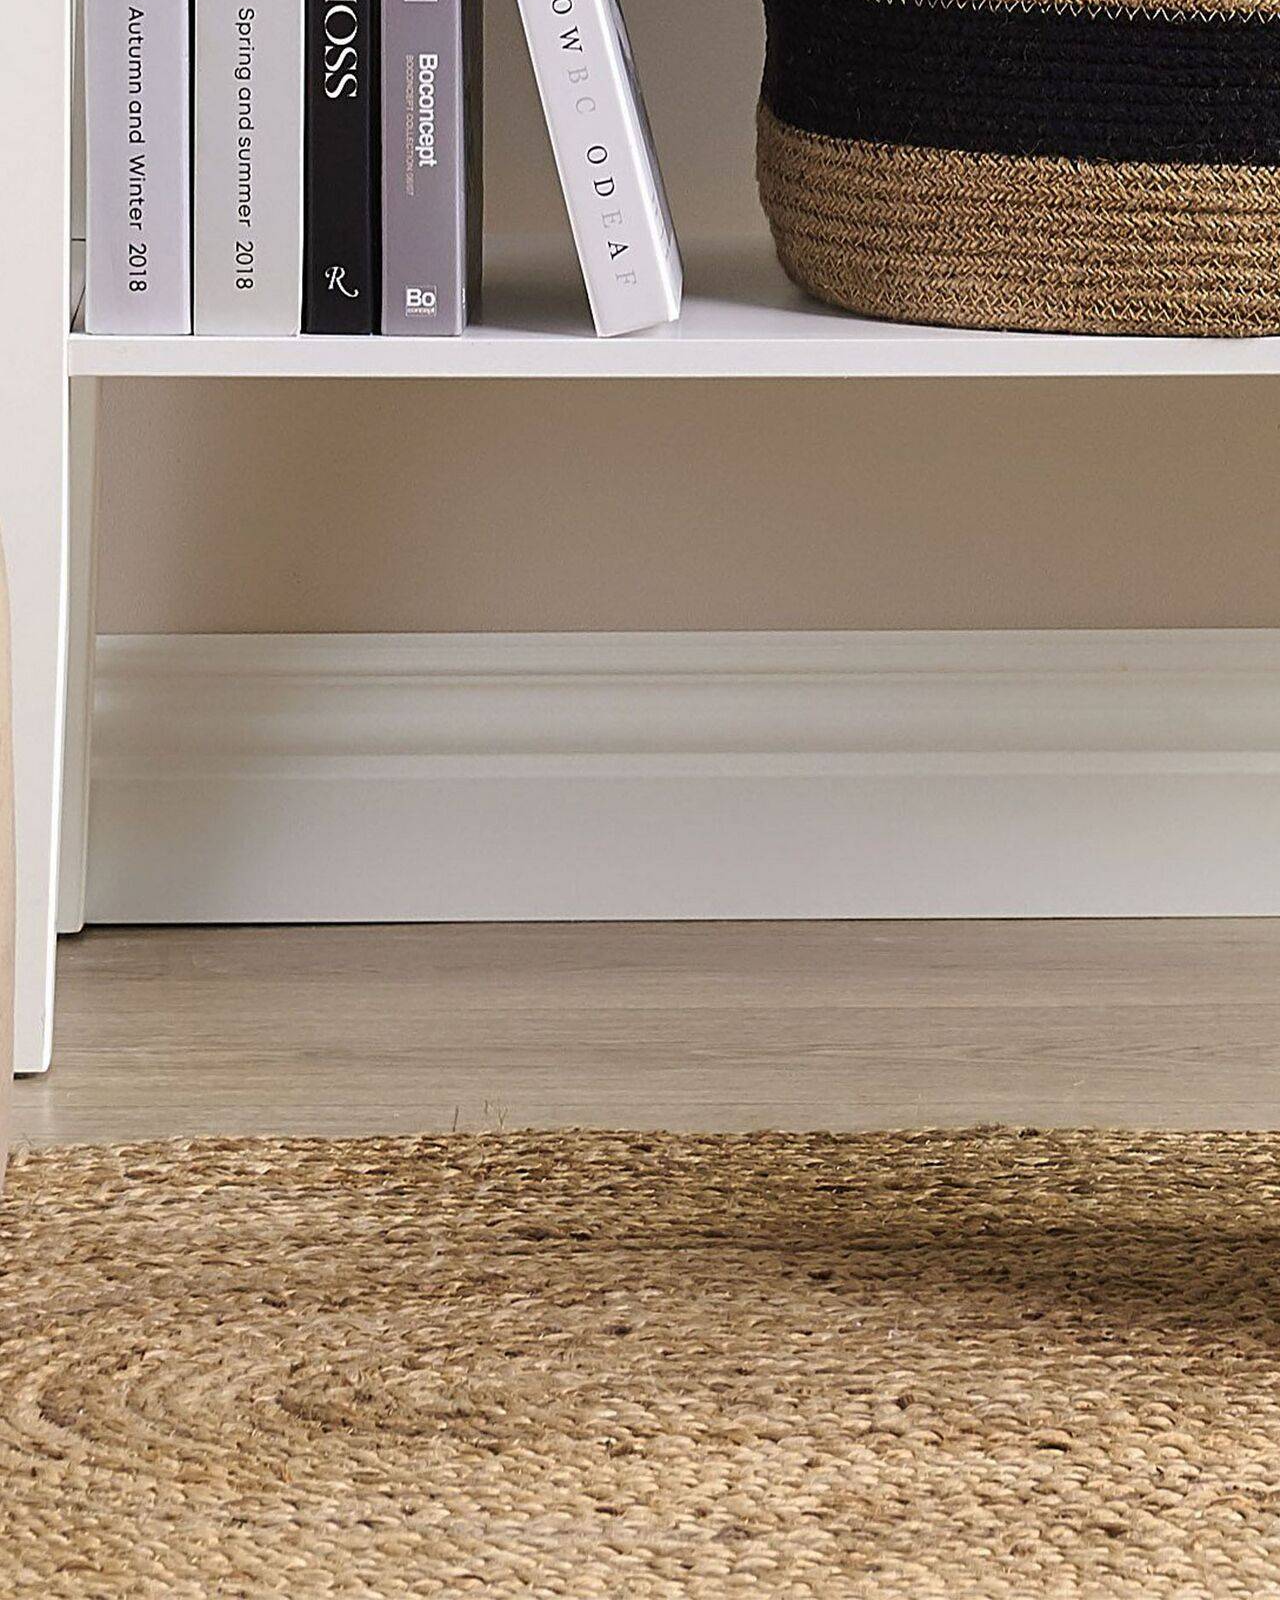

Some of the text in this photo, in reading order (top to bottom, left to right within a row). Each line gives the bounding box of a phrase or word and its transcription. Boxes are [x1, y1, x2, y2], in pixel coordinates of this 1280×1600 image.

[128, 6, 144, 94] Autumn
[234, 8, 255, 80] Spring
[128, 100, 146, 144] and
[238, 87, 255, 130] and
[414, 53, 439, 168] Boconcept
[129, 154, 146, 231] Winter
[238, 137, 251, 228] summer
[128, 243, 147, 292] 2018
[235, 241, 254, 290] 2018
